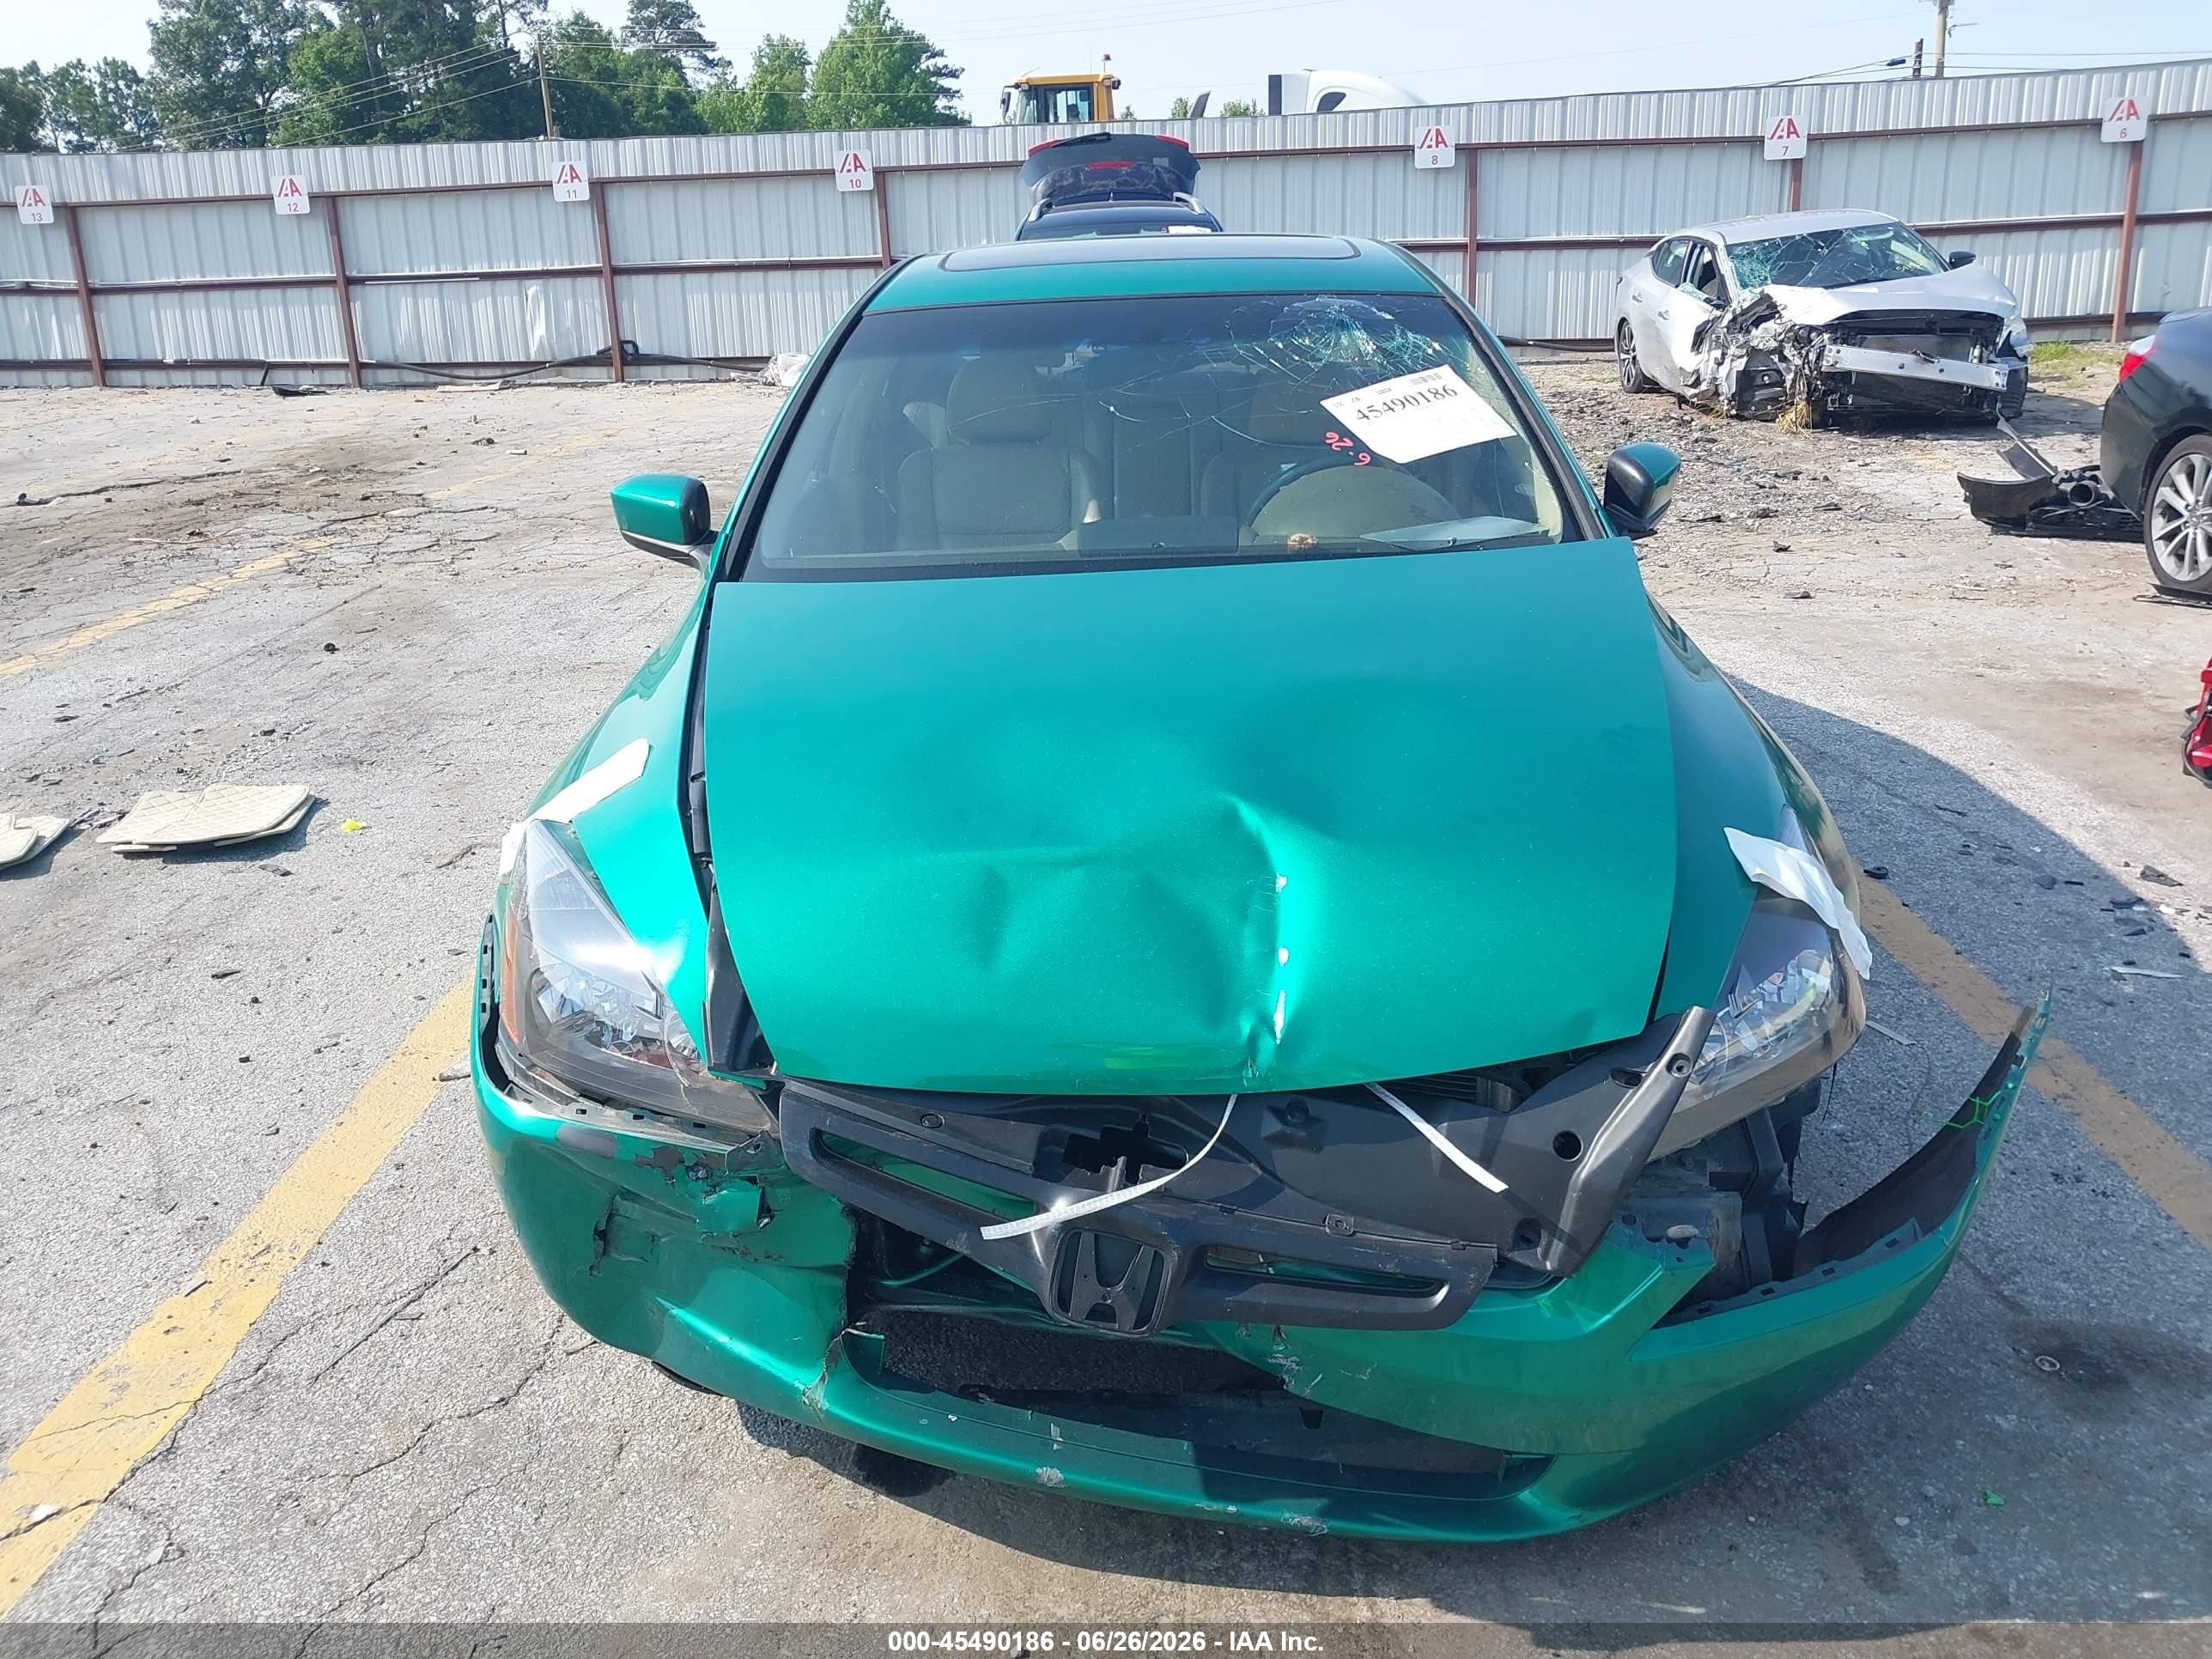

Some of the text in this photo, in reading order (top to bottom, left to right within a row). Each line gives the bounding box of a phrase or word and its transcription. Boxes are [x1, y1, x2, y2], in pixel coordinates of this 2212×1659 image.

[2119, 128, 2128, 139] 6
[1781, 146, 1790, 156] 7
[1431, 155, 1439, 165] 8
[848, 179, 862, 189] 10
[566, 189, 577, 199] 11
[287, 202, 299, 212] 12
[31, 212, 43, 222] 13
[1357, 384, 1458, 421] 45490186
